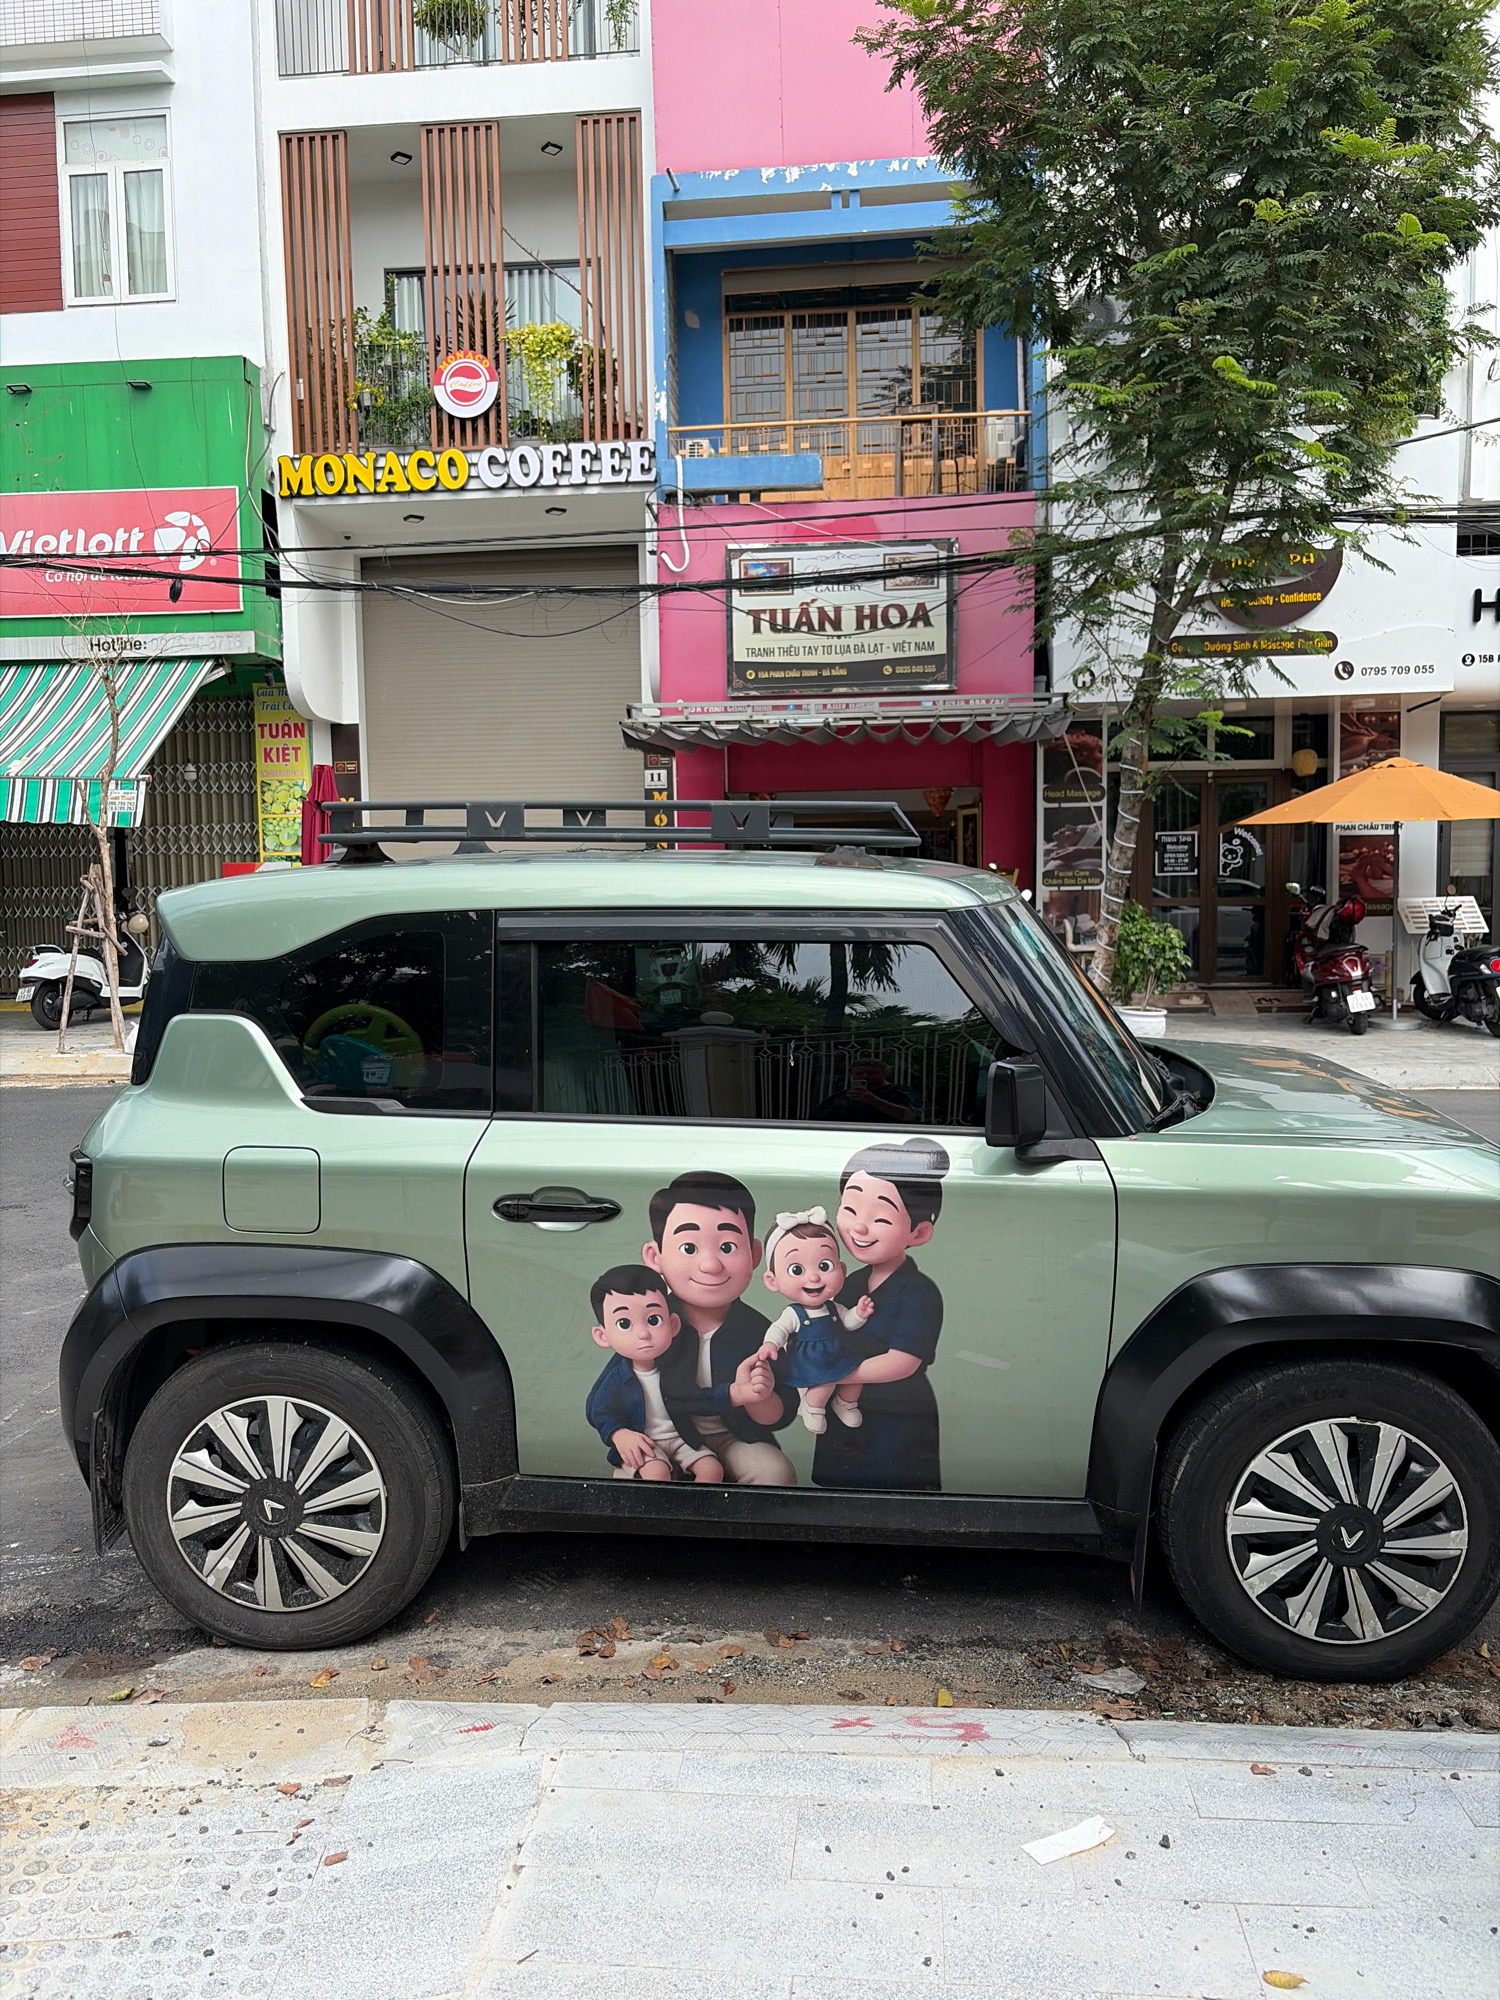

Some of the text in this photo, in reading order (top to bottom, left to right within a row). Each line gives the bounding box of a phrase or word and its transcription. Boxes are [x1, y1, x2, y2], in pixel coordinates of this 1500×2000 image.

[439, 351, 490, 371] MONACO
[278, 441, 657, 497] MONACO COFFEE
[0, 527, 145, 556] Vietlott
[815, 584, 863, 593] GALLERY
[1280, 592, 1322, 604] Confidence
[747, 599, 935, 634] TUẤN HOA
[746, 647, 775, 658] TRANH
[777, 644, 800, 657] THÊU
[802, 645, 819, 656] TAY
[821, 645, 833, 656] TƠ
[834, 644, 851, 657] LỤA
[853, 641, 866, 654] ĐÀ
[868, 643, 884, 656] LẠT
[892, 640, 912, 654] VIỆT
[914, 641, 935, 652] NAM
[1233, 641, 1251, 650] Sinh
[1479, 654, 1494, 663] 15B
[1361, 664, 1435, 676] 0795 709 055
[257, 717, 306, 739] TUẤN
[263, 744, 302, 767] KIỆT
[650, 772, 661, 782] 11
[1044, 790, 1065, 798] Head
[1358, 822, 1379, 830] CHÂU
